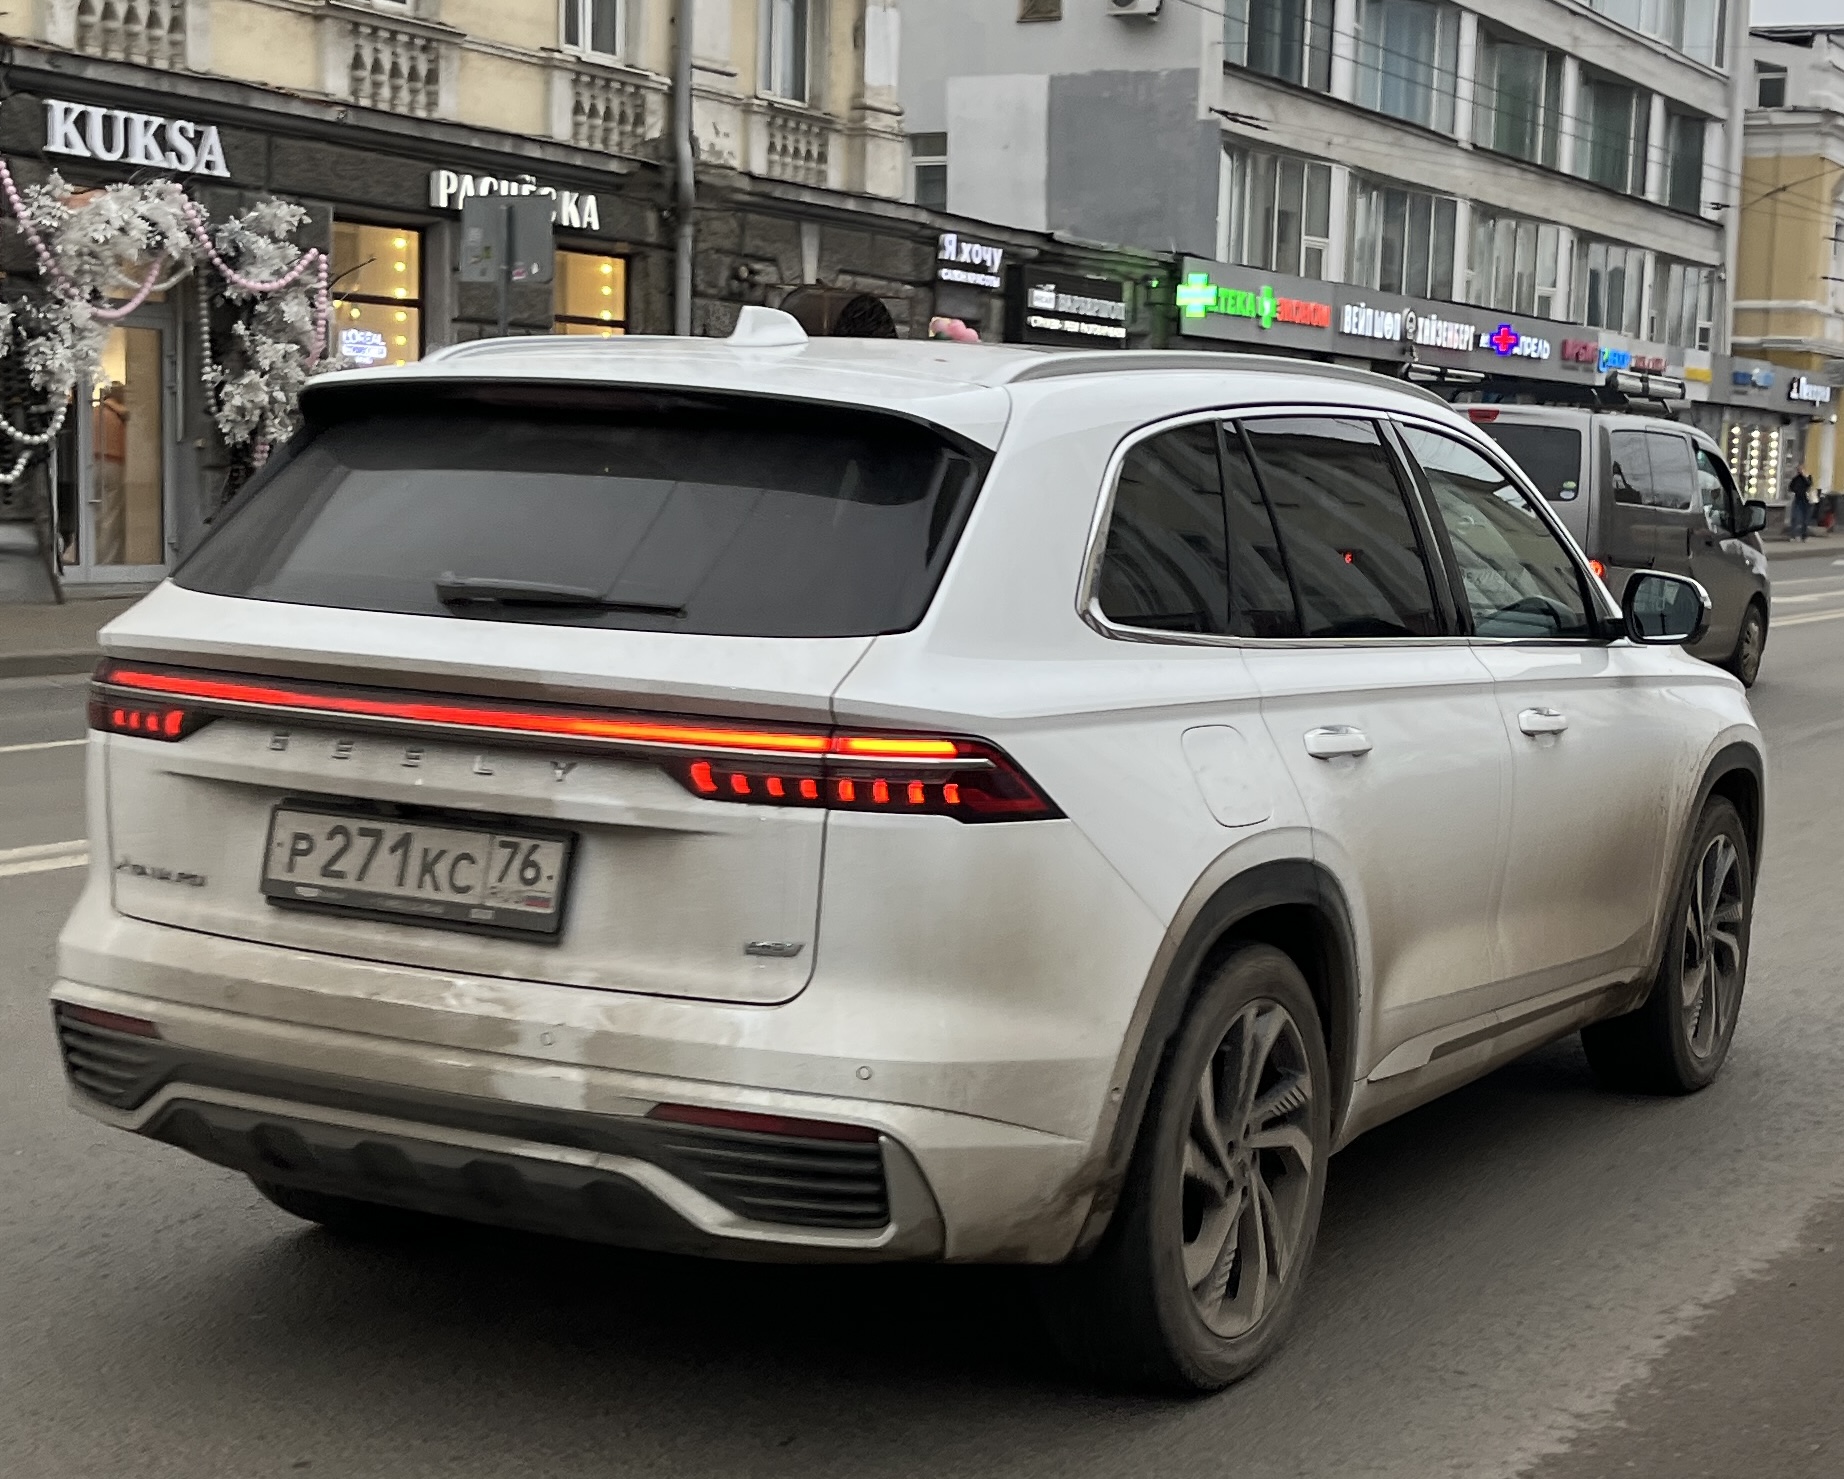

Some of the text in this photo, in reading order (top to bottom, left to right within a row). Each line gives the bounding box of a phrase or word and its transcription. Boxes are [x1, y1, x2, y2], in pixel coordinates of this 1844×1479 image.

[42, 99, 231, 177] KUKSA
[938, 233, 1003, 273] Я хочу
[1341, 302, 1374, 337] ВЕЙП
[1373, 309, 1401, 341] ШОП
[496, 840, 542, 887] 76
